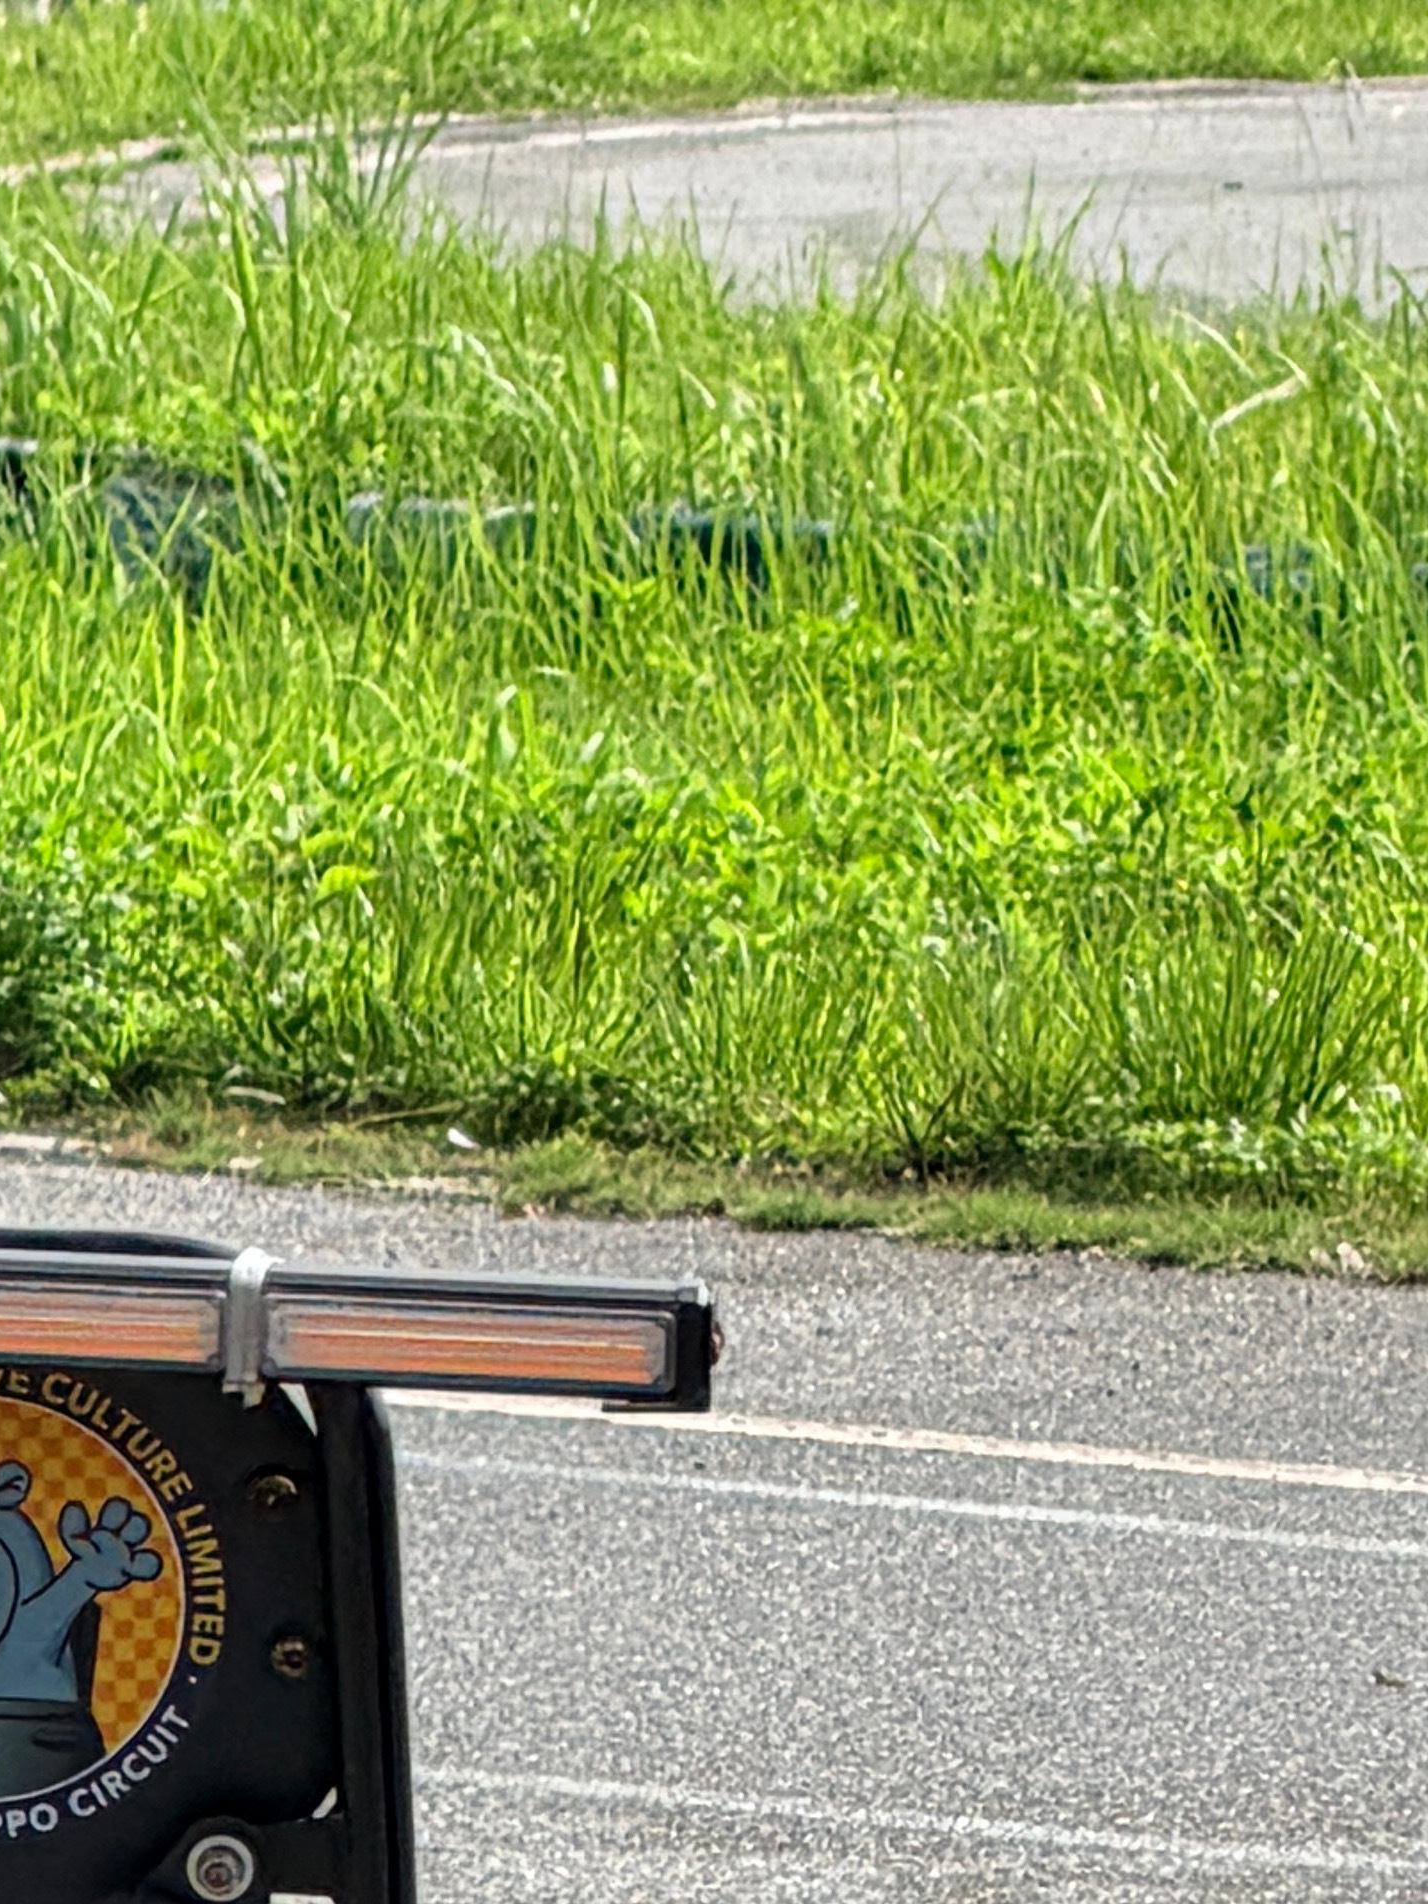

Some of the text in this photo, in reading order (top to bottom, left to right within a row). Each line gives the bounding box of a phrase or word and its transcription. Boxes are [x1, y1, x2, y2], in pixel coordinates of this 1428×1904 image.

[42, 1372, 194, 1501] CULTURE
[176, 1504, 226, 1665] LIMITED
[67, 1705, 190, 1818] CIRCUIT
